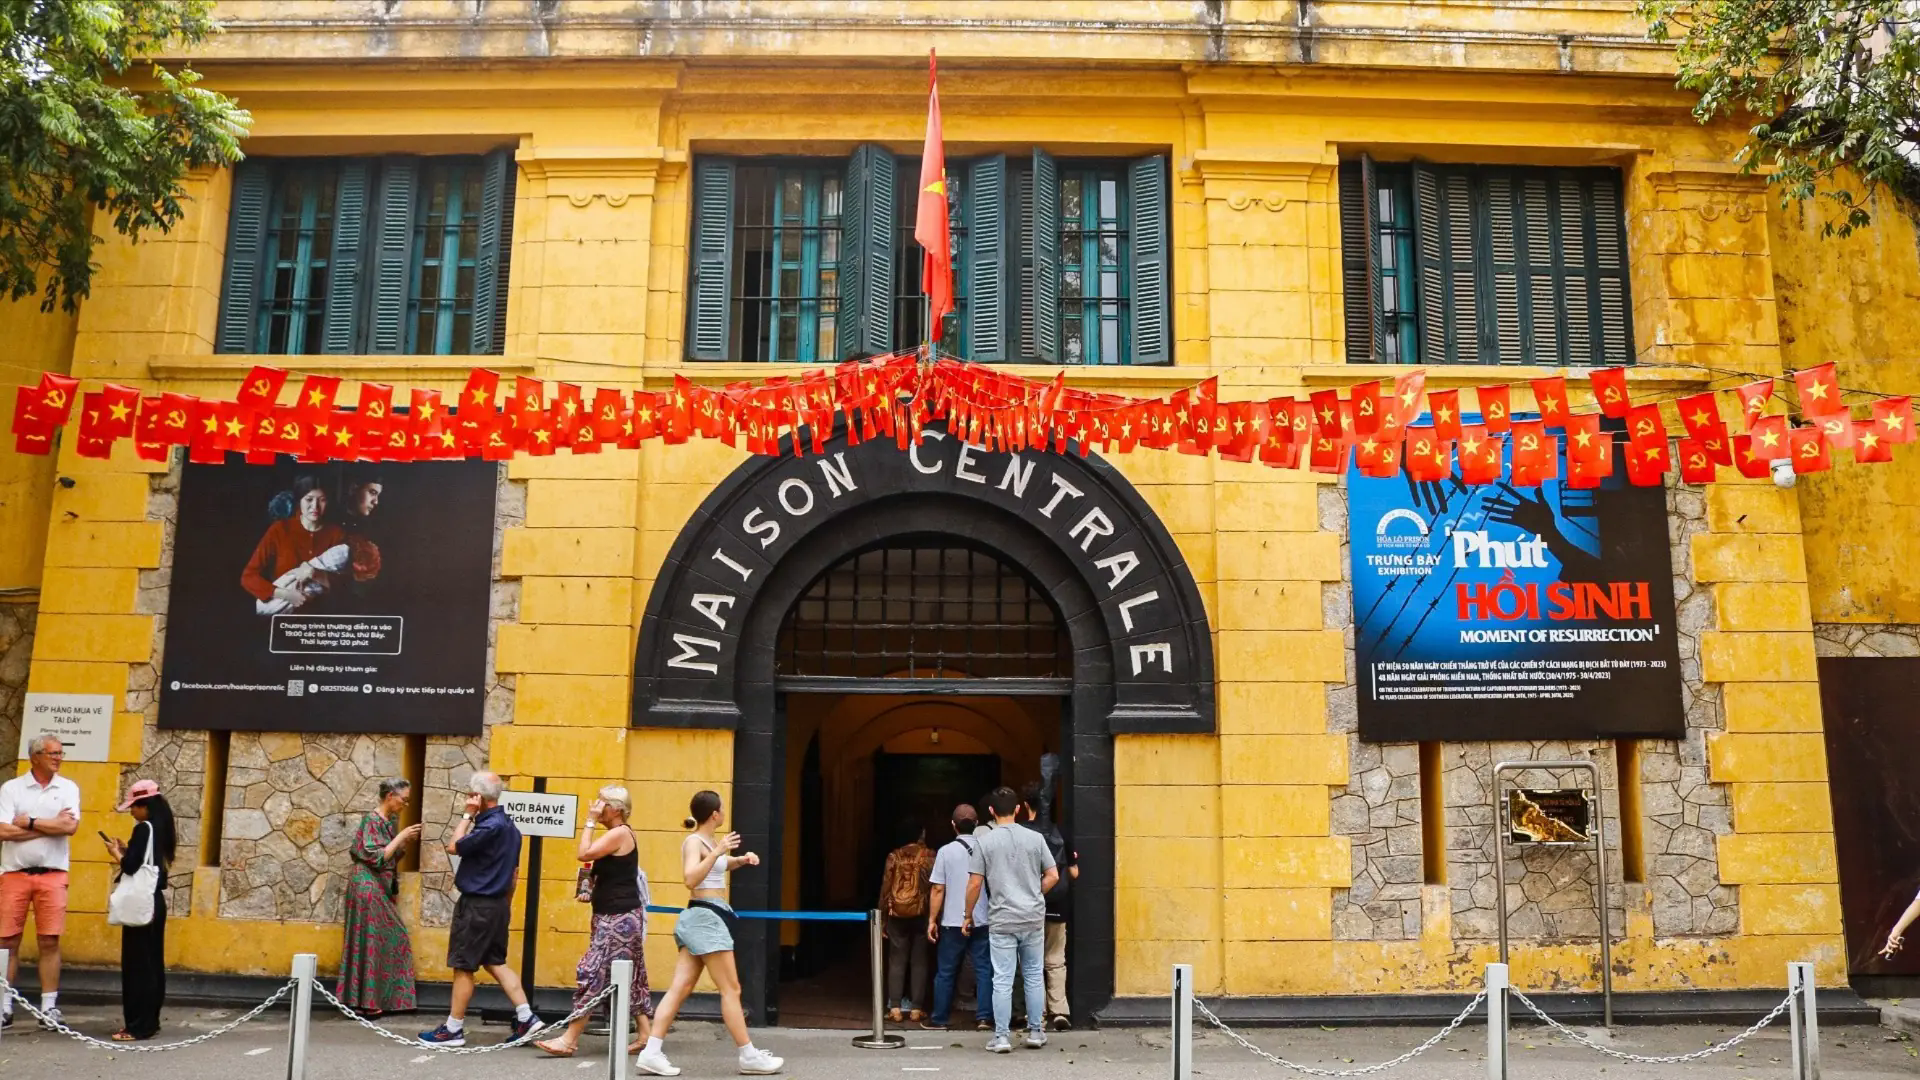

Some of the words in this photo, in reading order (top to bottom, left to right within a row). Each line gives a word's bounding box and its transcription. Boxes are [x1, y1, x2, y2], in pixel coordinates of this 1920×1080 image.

[667, 451, 859, 675] MAISON
[909, 429, 1173, 677] CENTRALE
[1366, 554, 1413, 566] TRƯNG
[1416, 553, 1442, 566] BÀY
[1456, 568, 1541, 620] HỒI
[1546, 580, 1652, 620] SINH
[1460, 630, 1530, 644] MOMENT
[1532, 630, 1547, 643] OF
[34, 704, 49, 713] XẾP
[51, 705, 72, 714] HÀNG
[92, 706, 103, 714] VÉ
[507, 802, 525, 812] NƠI
[529, 803, 550, 813] BÁN
[552, 804, 565, 814] VÉ
[536, 816, 564, 825] Office
